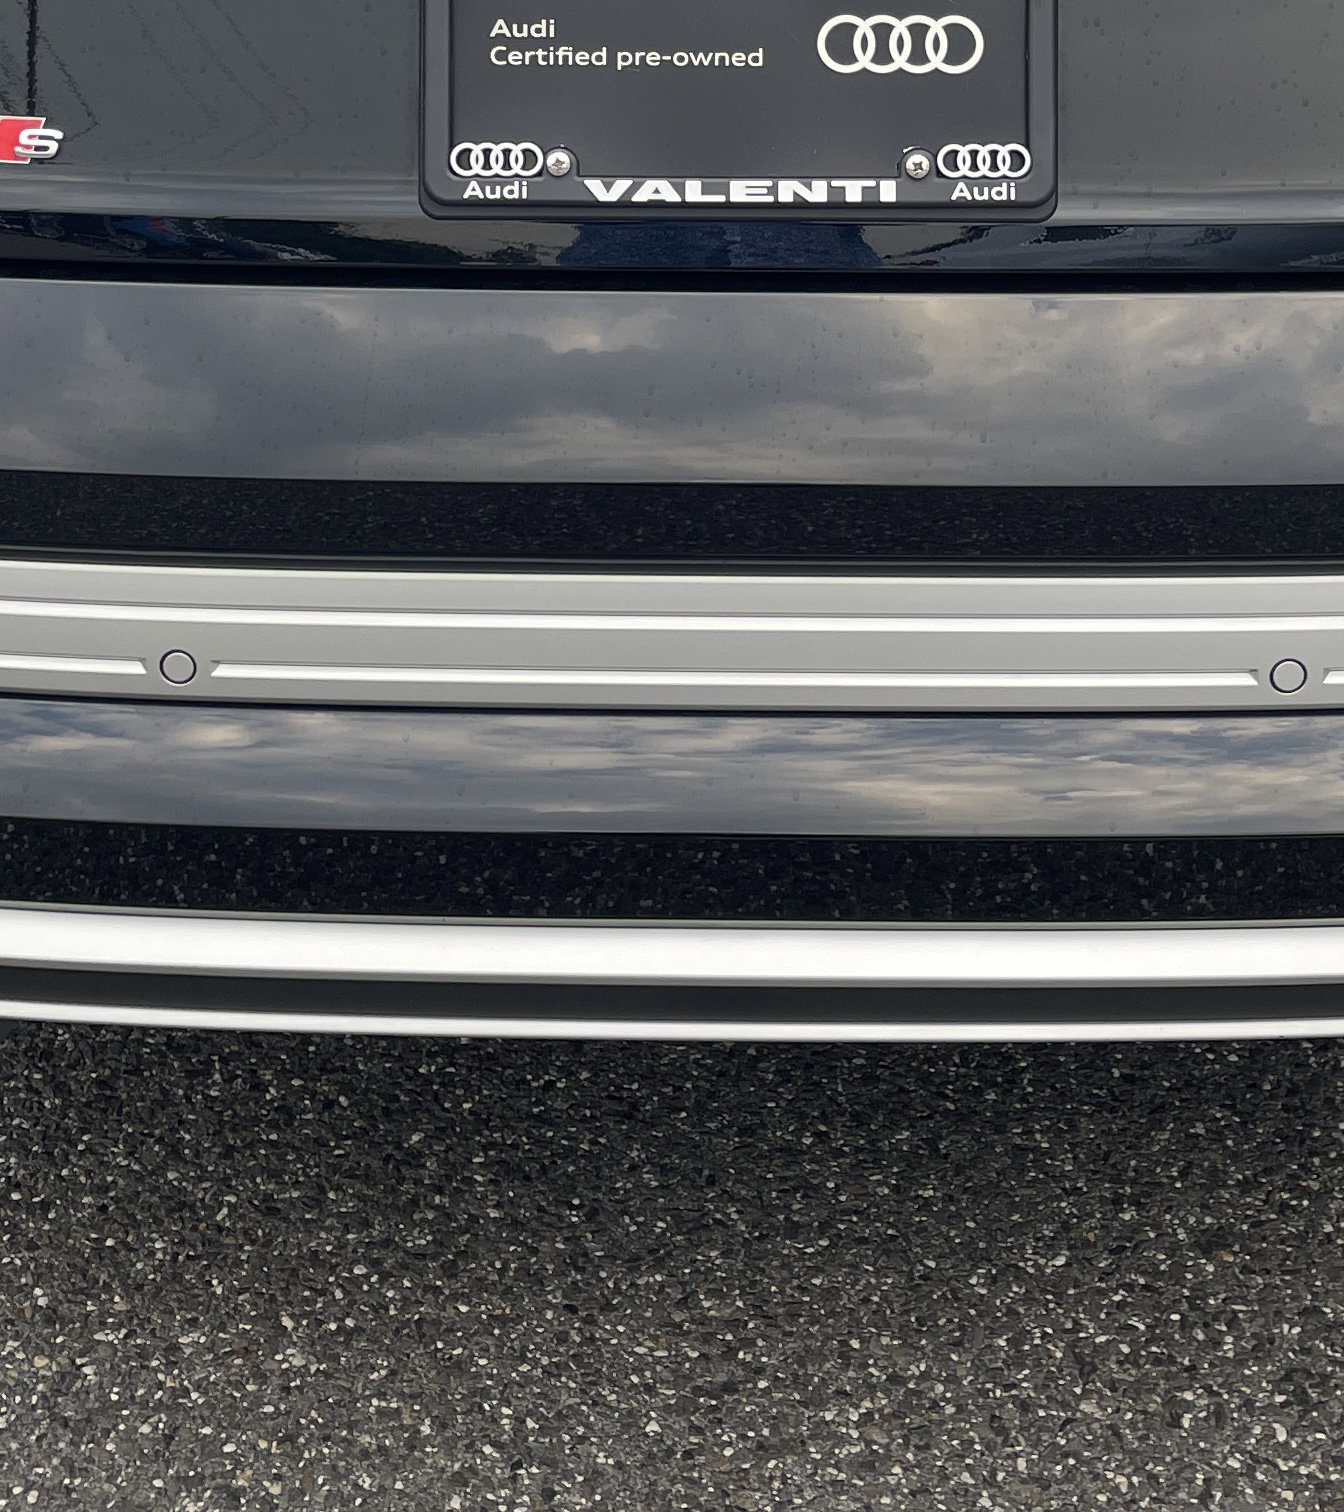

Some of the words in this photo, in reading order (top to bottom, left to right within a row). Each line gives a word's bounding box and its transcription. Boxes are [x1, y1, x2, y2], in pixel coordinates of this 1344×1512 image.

[489, 18, 555, 38] Audi
[490, 45, 608, 67] Certified
[616, 46, 764, 71] pre-owned
[462, 180, 529, 200] Audi
[582, 179, 898, 203] VALENTI
[950, 181, 1017, 201] Audi
